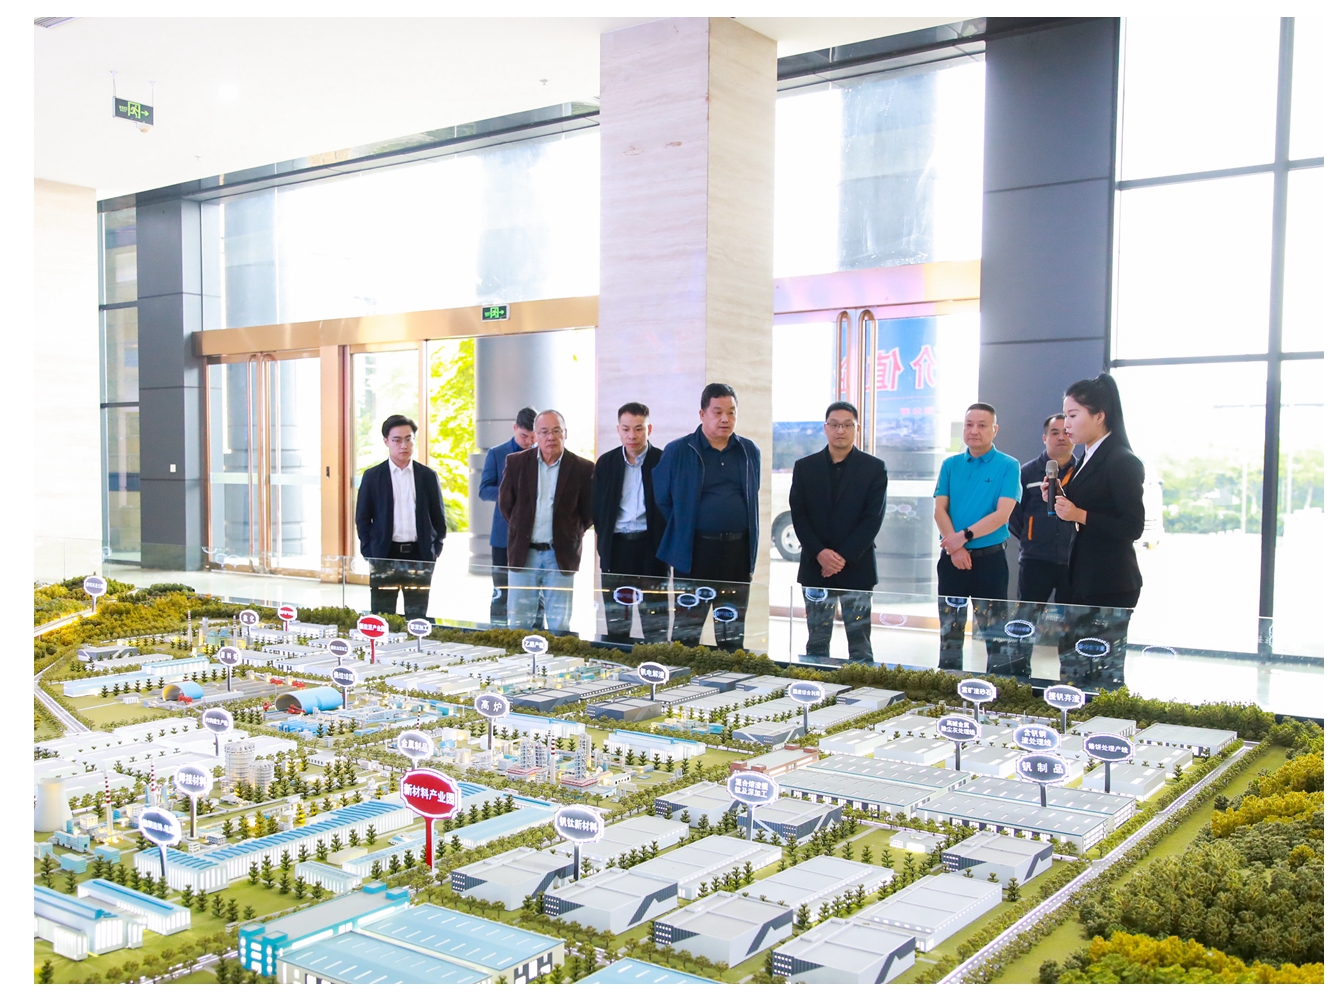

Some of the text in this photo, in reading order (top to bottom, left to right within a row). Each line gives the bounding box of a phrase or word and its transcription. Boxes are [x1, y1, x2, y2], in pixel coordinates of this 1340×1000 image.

[481, 699, 503, 712] 高炉
[401, 739, 429, 753] 金属制品
[1021, 760, 1064, 774] 钒制品
[178, 772, 208, 788] 焊接材料
[403, 782, 456, 806] 新材料产业园
[559, 815, 599, 834] 钒钛新材料
